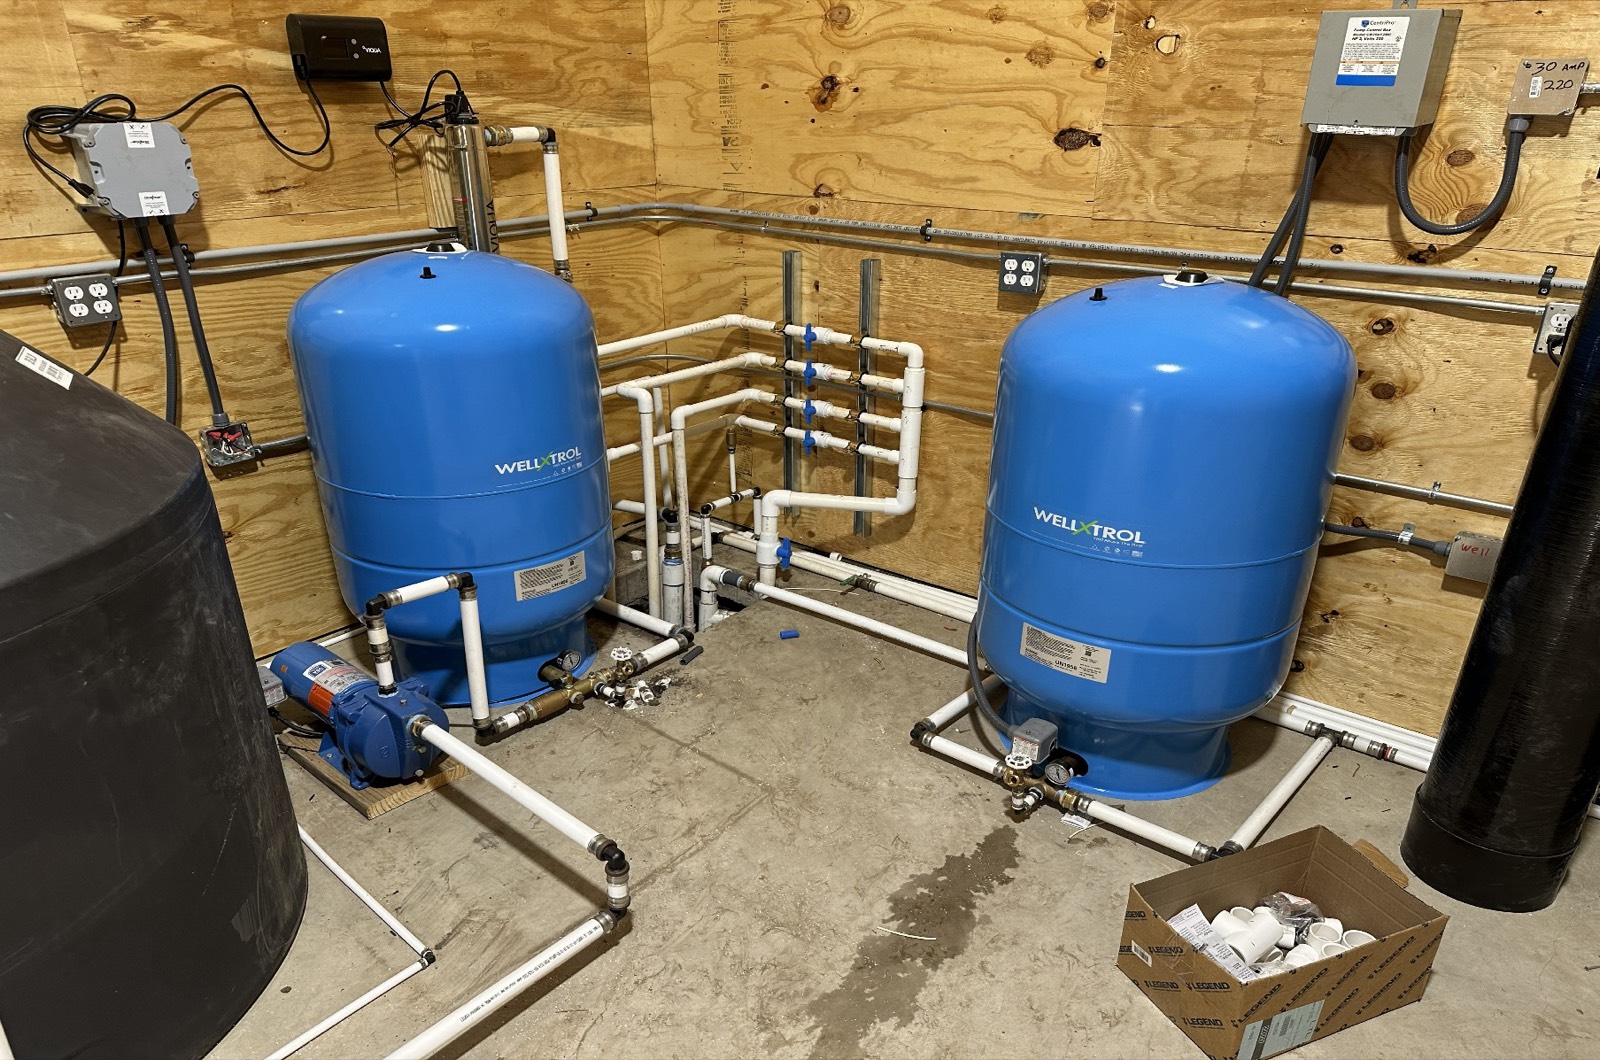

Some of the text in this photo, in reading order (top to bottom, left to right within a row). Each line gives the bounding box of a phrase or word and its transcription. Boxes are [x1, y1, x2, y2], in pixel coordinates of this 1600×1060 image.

[1531, 61, 1558, 76] 30
[1561, 61, 1586, 72] AMP
[1543, 79, 1574, 91] 220
[1191, 982, 1231, 990] LEGEND
[1187, 1018, 1223, 1027] LEGEND
